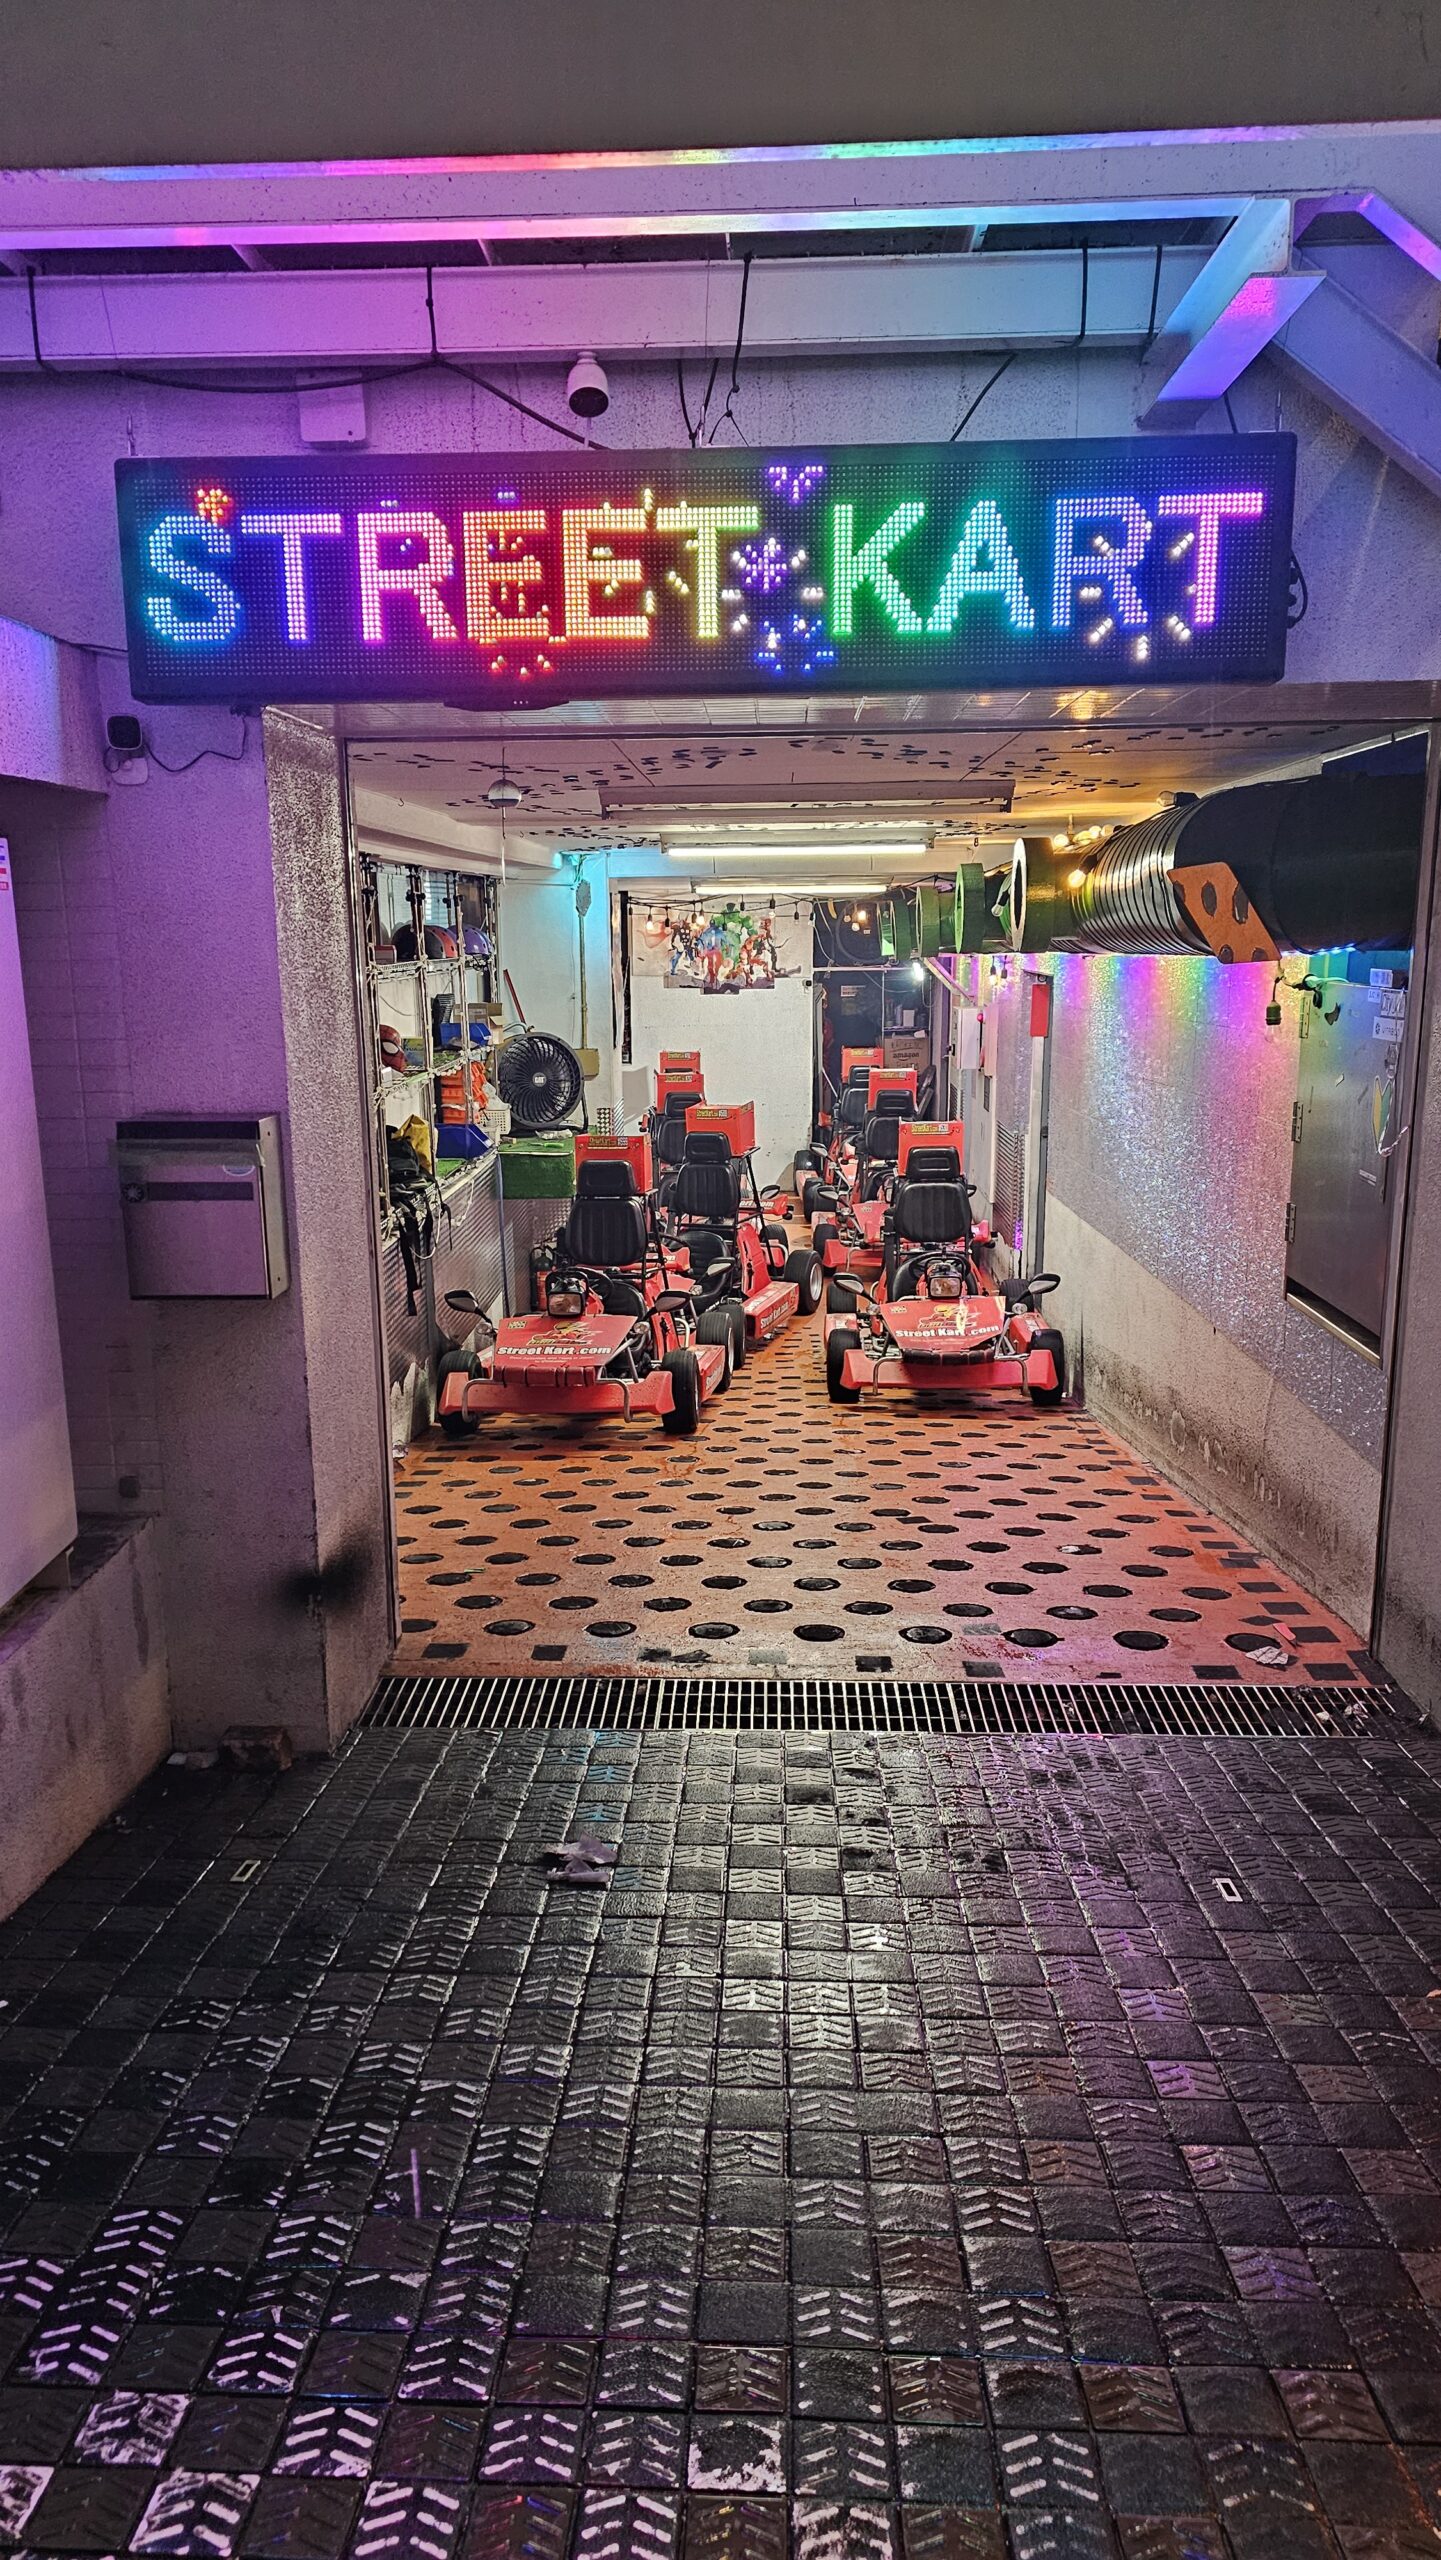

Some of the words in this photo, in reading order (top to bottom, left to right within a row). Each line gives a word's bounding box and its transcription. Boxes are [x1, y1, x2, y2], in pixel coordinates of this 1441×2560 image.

[146, 506, 759, 641] STREET
[832, 491, 1264, 636] KART
[895, 1329, 936, 1337] Street
[936, 1328, 966, 1337] Kart
[497, 1346, 543, 1355] Street
